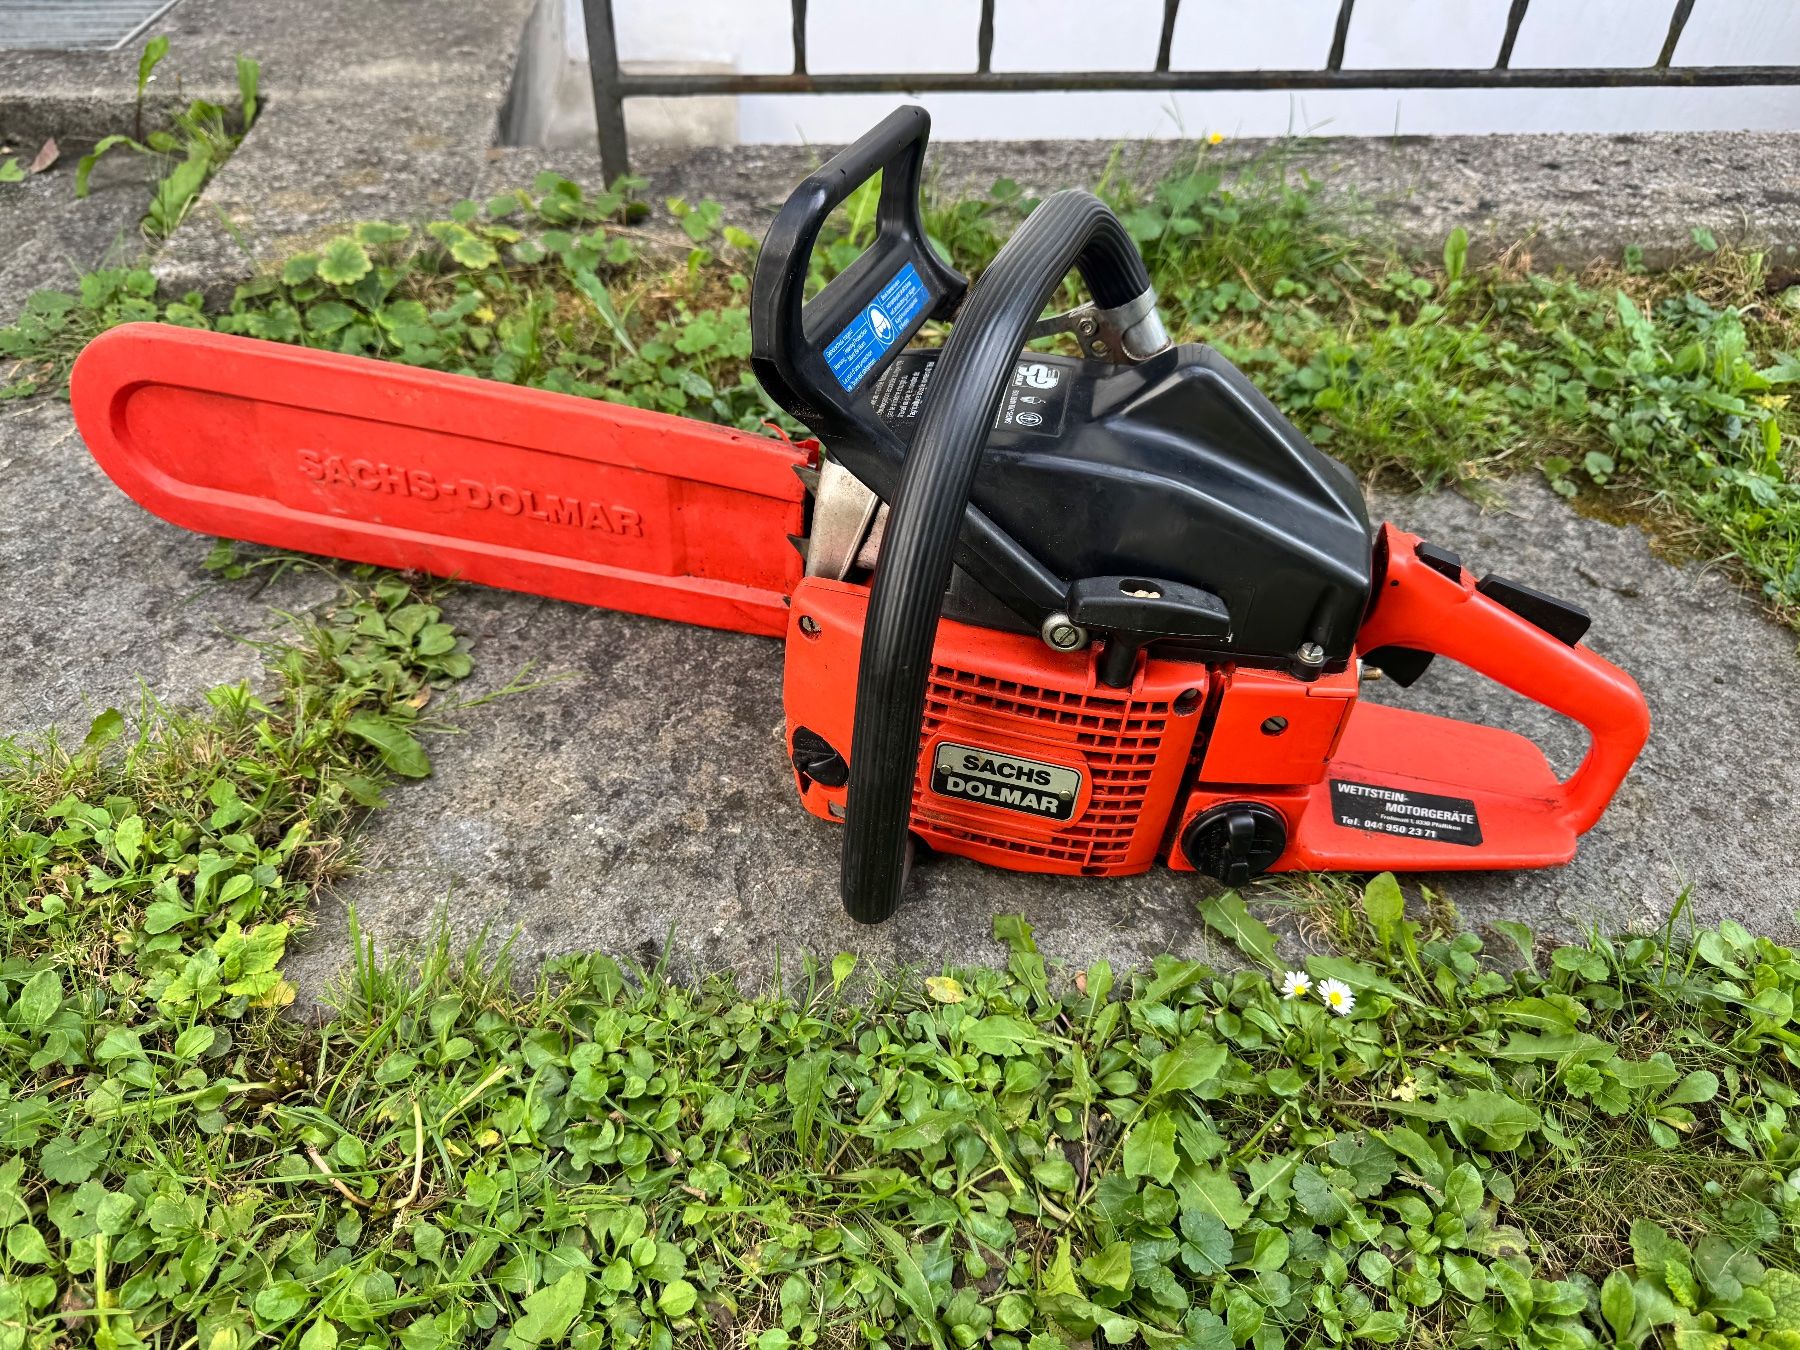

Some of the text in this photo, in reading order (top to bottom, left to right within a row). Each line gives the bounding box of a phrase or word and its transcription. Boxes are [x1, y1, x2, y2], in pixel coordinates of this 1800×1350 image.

[298, 448, 645, 537] SACHS-DOLMAR
[962, 754, 1051, 786] SACHS
[946, 775, 1059, 813] DOLMAR
[1337, 783, 1408, 802] WETTSTEIN-
[1341, 815, 1437, 838] Tel. 044 950 23 71
[1385, 802, 1475, 824] MOTORGERÄTE
